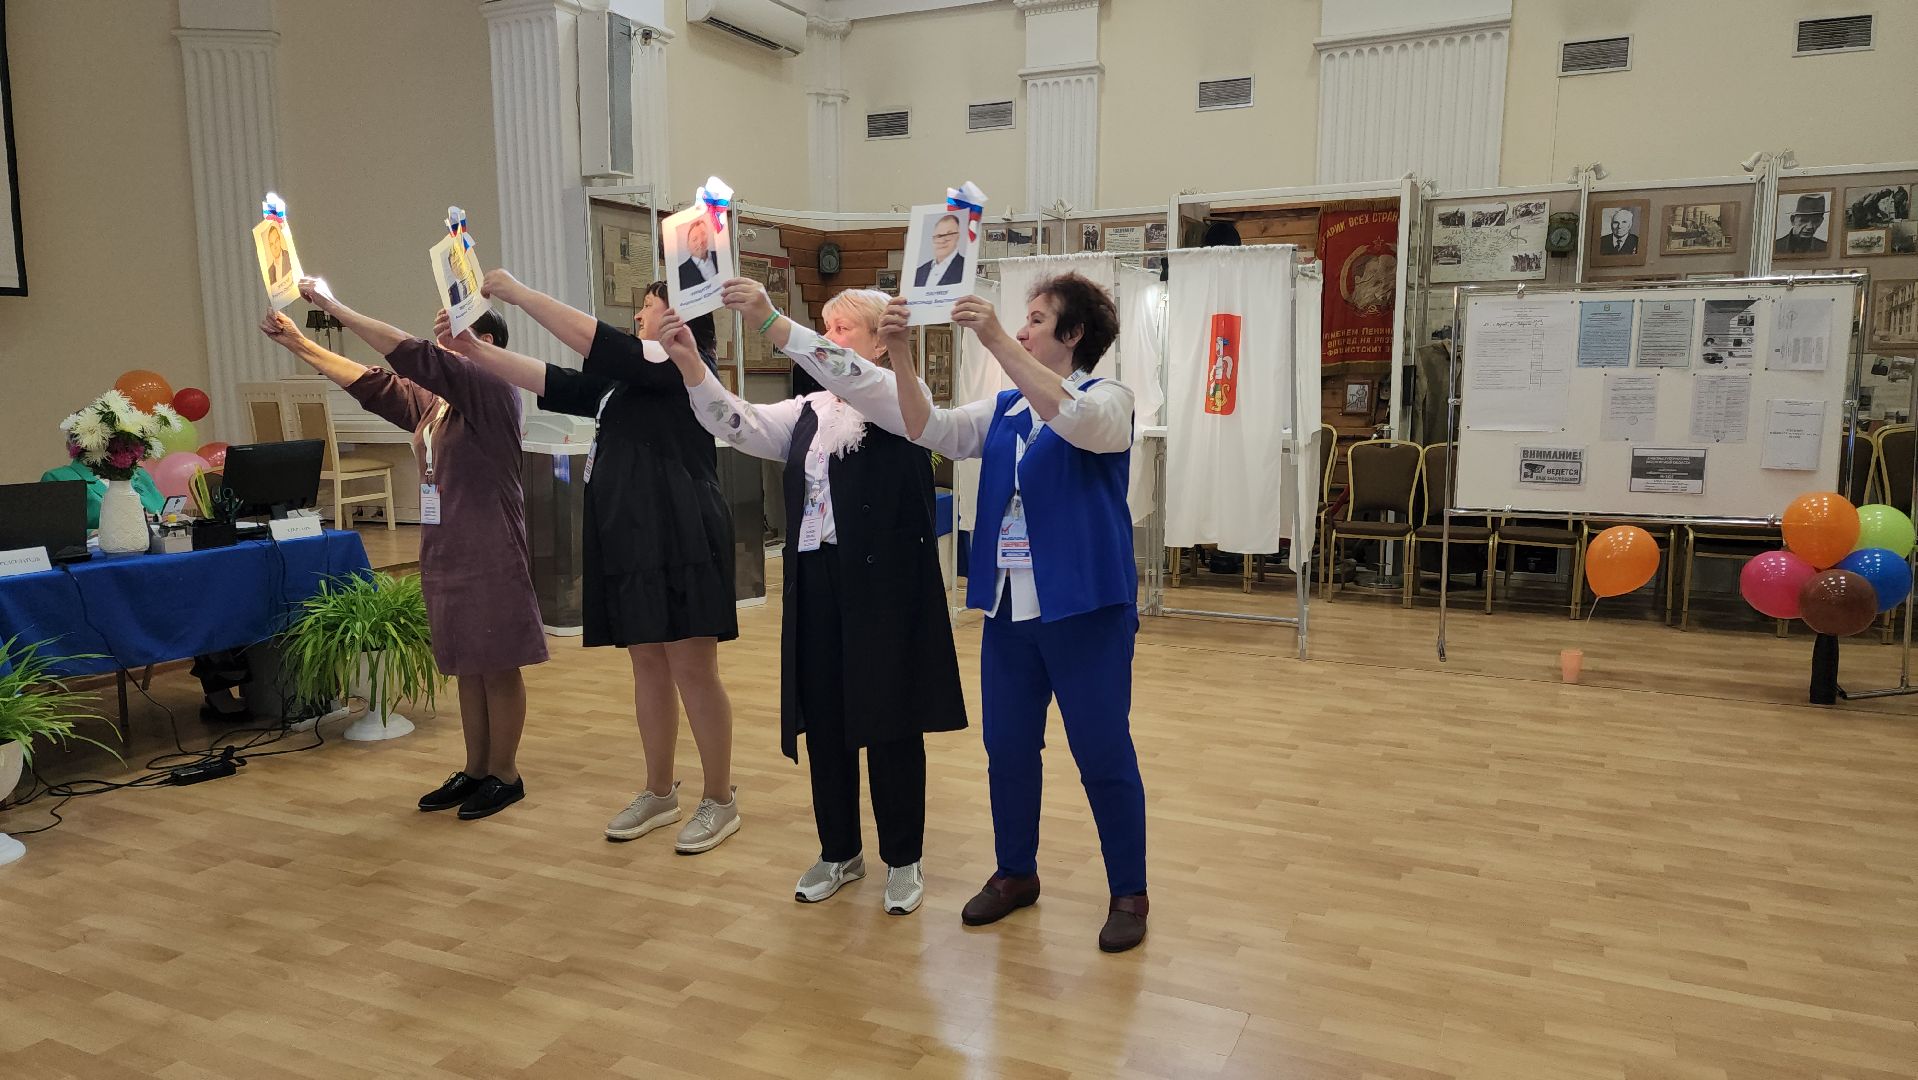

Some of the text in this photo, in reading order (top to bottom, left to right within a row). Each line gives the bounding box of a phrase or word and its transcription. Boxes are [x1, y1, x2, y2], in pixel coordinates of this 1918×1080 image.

[1348, 213, 1370, 228] ВСЕХ
[1372, 211, 1399, 223] СТРАН
[1522, 449, 1582, 461] ВНИМАНИЕ!
[1546, 468, 1579, 477] ВЕДЕТСЯ
